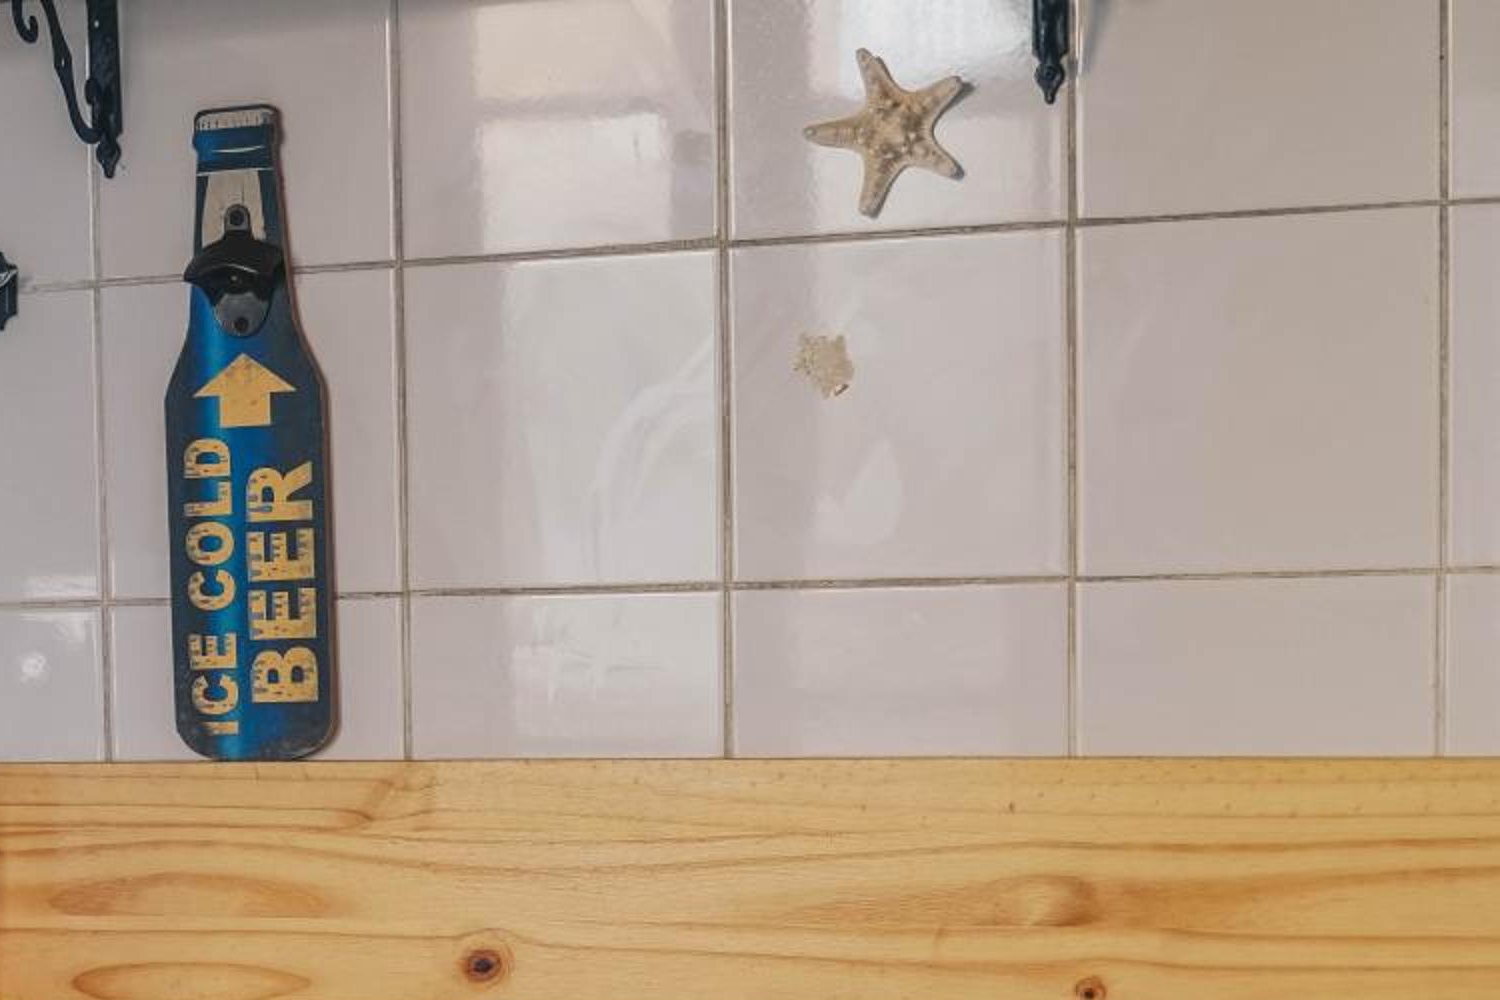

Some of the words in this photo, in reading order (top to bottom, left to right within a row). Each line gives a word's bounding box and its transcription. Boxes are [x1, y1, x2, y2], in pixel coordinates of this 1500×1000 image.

[183, 438, 237, 611] COLD
[245, 461, 319, 703] BEER
[188, 632, 239, 735] ICE
